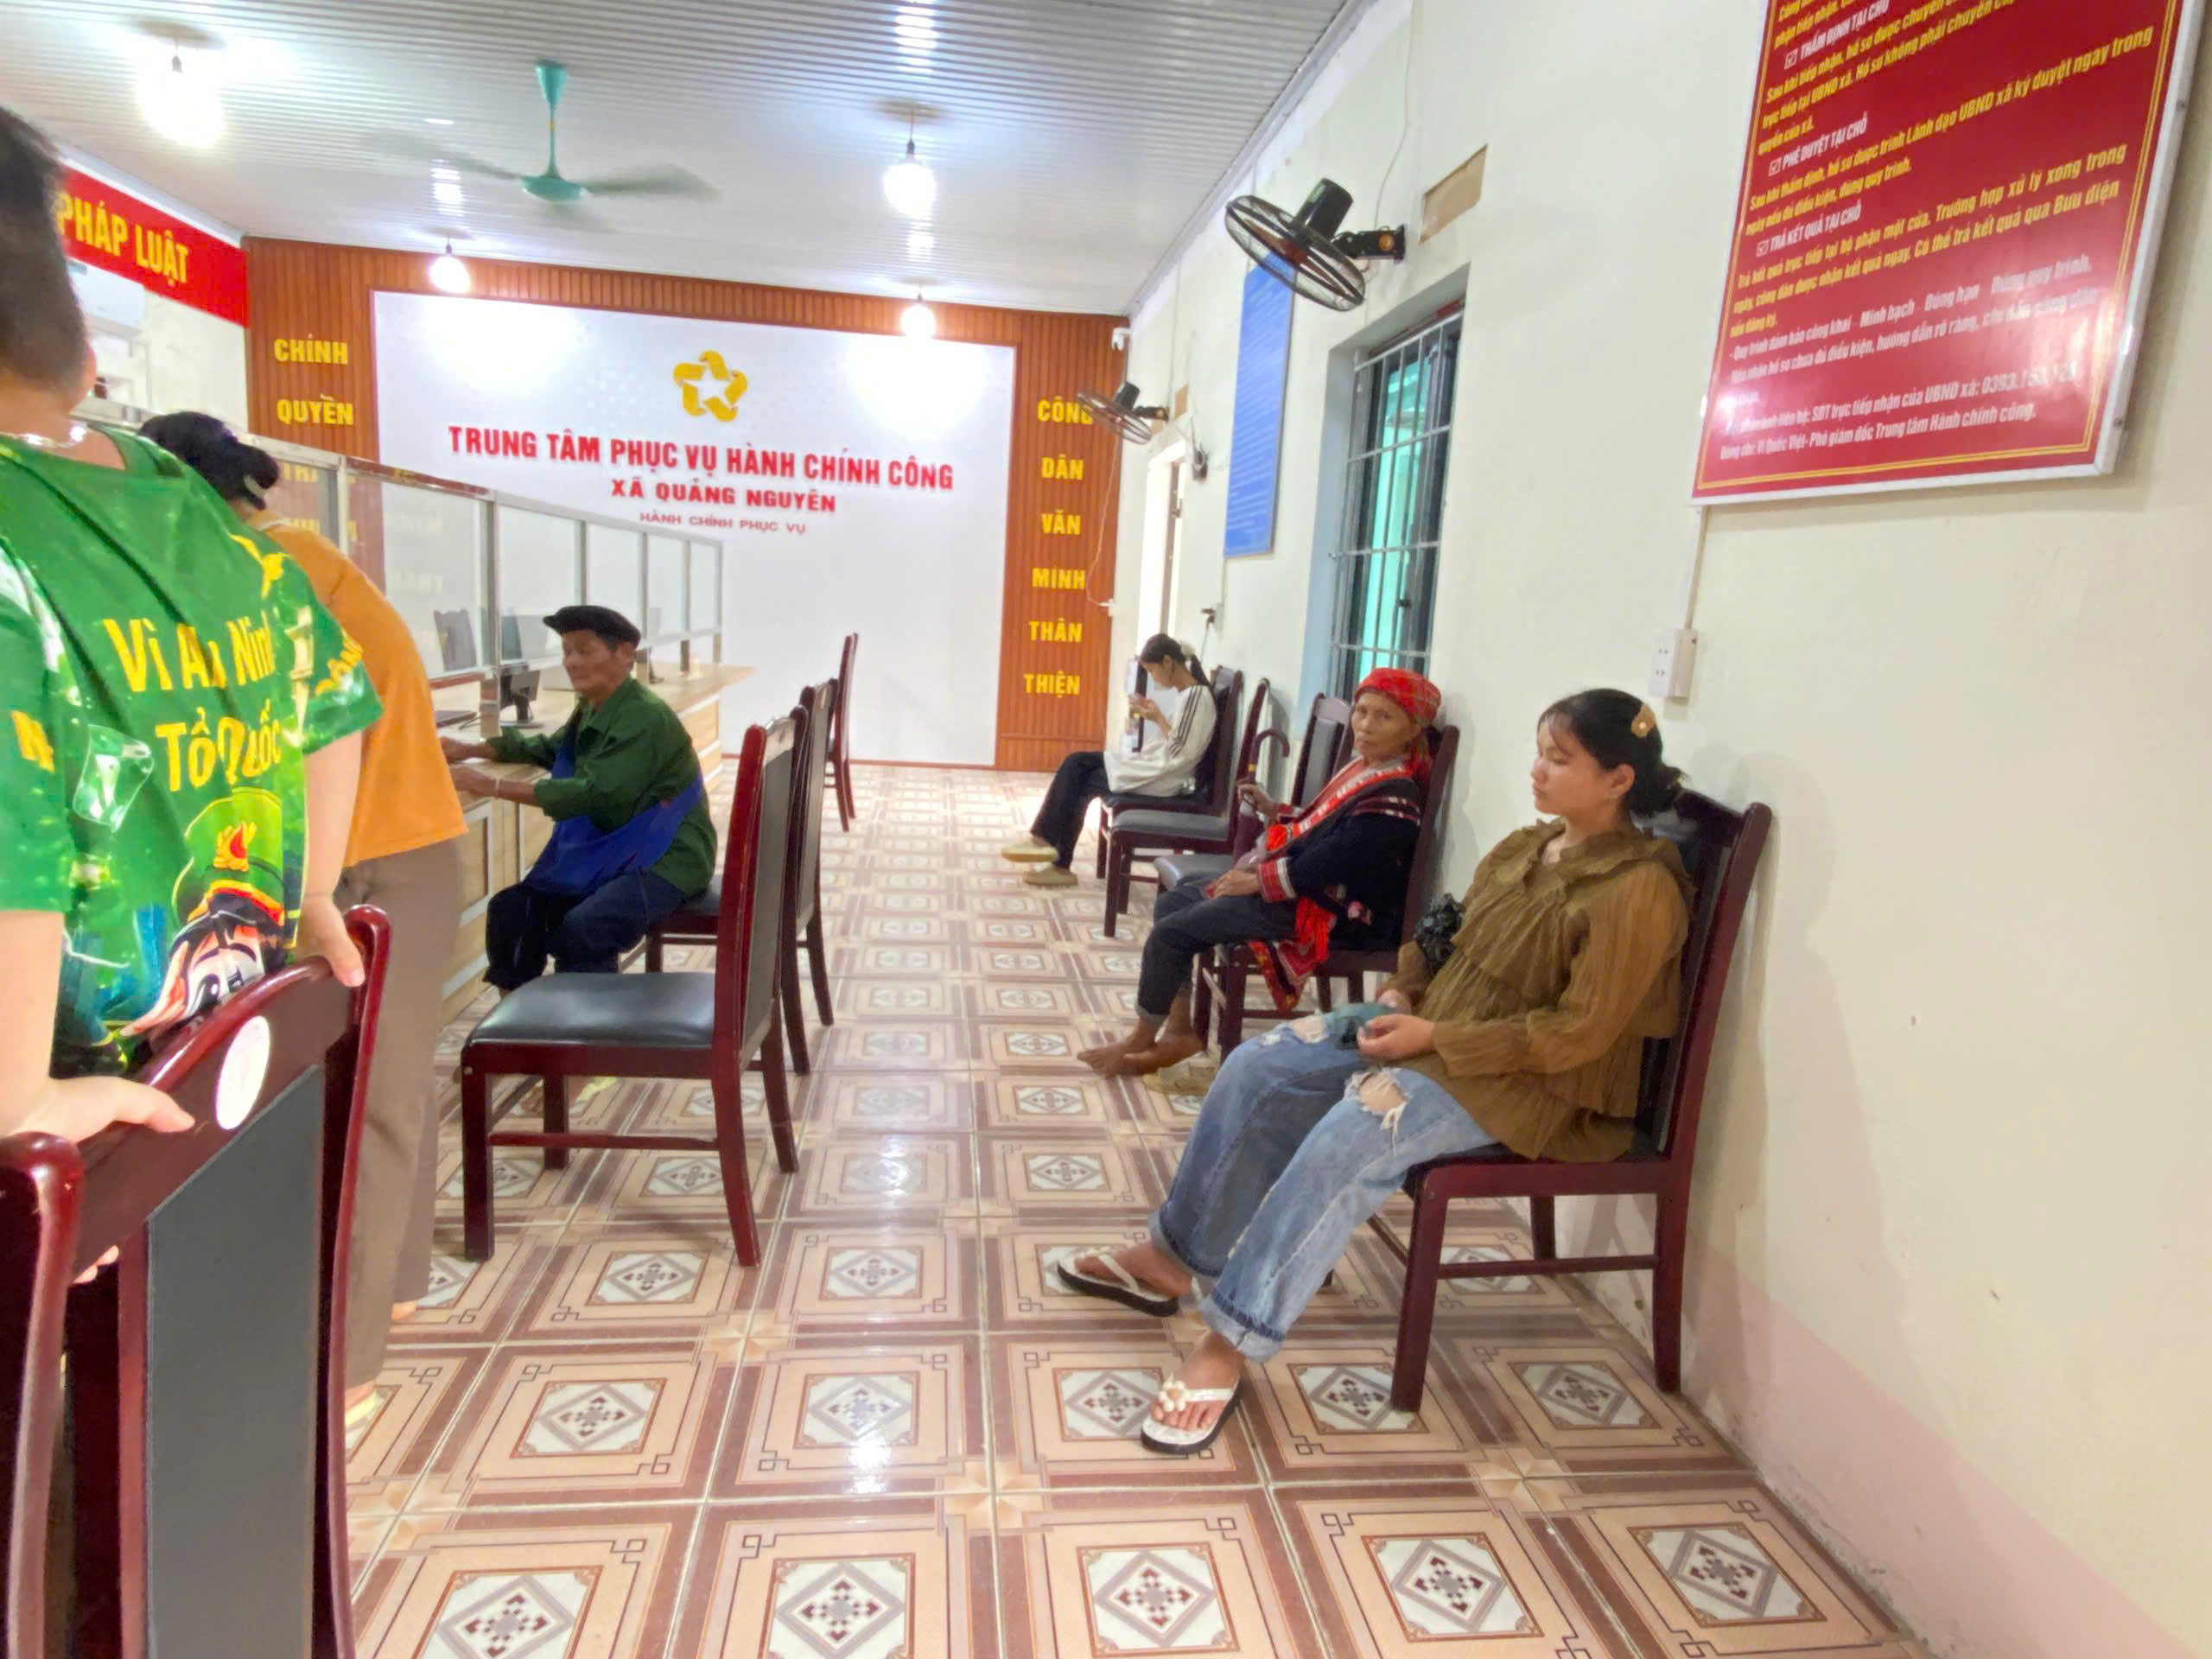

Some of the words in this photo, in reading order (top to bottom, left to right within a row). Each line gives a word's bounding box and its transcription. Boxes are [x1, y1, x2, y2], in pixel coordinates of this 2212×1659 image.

[1935, 111, 1956, 131] đạo
[1960, 92, 1993, 120] UBND
[1996, 84, 2012, 105] xã
[2013, 79, 2031, 97] ký
[2032, 59, 2070, 89] duyệt
[2074, 46, 2108, 72] ngay
[2112, 28, 2152, 56] trong
[1801, 136, 1828, 161] DUYỆT
[1831, 128, 1846, 147] TẠI
[1884, 219, 1904, 238] một
[1937, 197, 1975, 220] Trường
[1980, 187, 2003, 207] hợp
[2008, 177, 2025, 197] xử
[2046, 161, 2081, 183] xong
[2087, 145, 2126, 171] trong
[1824, 213, 1840, 230] TẠI
[1915, 240, 1929, 257] Có
[1973, 216, 1994, 238] kết
[1996, 211, 2020, 232] quả
[2024, 203, 2050, 224] qua
[2053, 193, 2082, 214] Bưu
[2085, 181, 2119, 205] điện
[54, 189, 130, 257] PHÁP
[134, 223, 188, 286] LUẬT
[1860, 308, 1885, 327] Minh
[1887, 300, 1915, 321] bạch
[1925, 291, 1955, 311] Đúng
[1956, 285, 1980, 303] hạn
[274, 333, 347, 365] CHÍNH
[276, 394, 353, 426] QUYỀN
[1037, 396, 1092, 424] CÔNG
[1831, 404, 1851, 419] trực
[1853, 398, 1872, 415] tiếp
[1873, 394, 1900, 412] nhận
[1902, 389, 1923, 406] của
[1925, 382, 1958, 402] UBND
[1854, 425, 1873, 441] đốc
[1877, 423, 1905, 437] Trung
[1906, 418, 1929, 434] tâm
[1930, 412, 1960, 430] Hành
[1962, 407, 1994, 426] chính
[448, 426, 537, 458] TRUNG
[546, 429, 601, 463] TÂM
[611, 438, 678, 473] PHỤC
[685, 444, 717, 477] VỤ
[726, 442, 796, 478] HÀNH
[804, 448, 880, 485] CHÍNH
[888, 454, 954, 490] CÔNG
[1041, 454, 1084, 480] DÂN
[611, 475, 645, 499] XÃ
[656, 478, 736, 505] QUẢNG
[746, 488, 836, 512] NGUYÊN
[640, 509, 681, 524] HÀNH
[689, 514, 733, 527] CHÍNH
[740, 518, 779, 532] PHỤC
[786, 523, 806, 535] VỤ
[1041, 510, 1081, 535] VĂN
[1032, 568, 1085, 589] MINH
[1030, 617, 1082, 642] THÂN
[103, 618, 174, 692] Vì
[1024, 670, 1080, 698] THIỆN
[155, 706, 215, 791] Tổ
